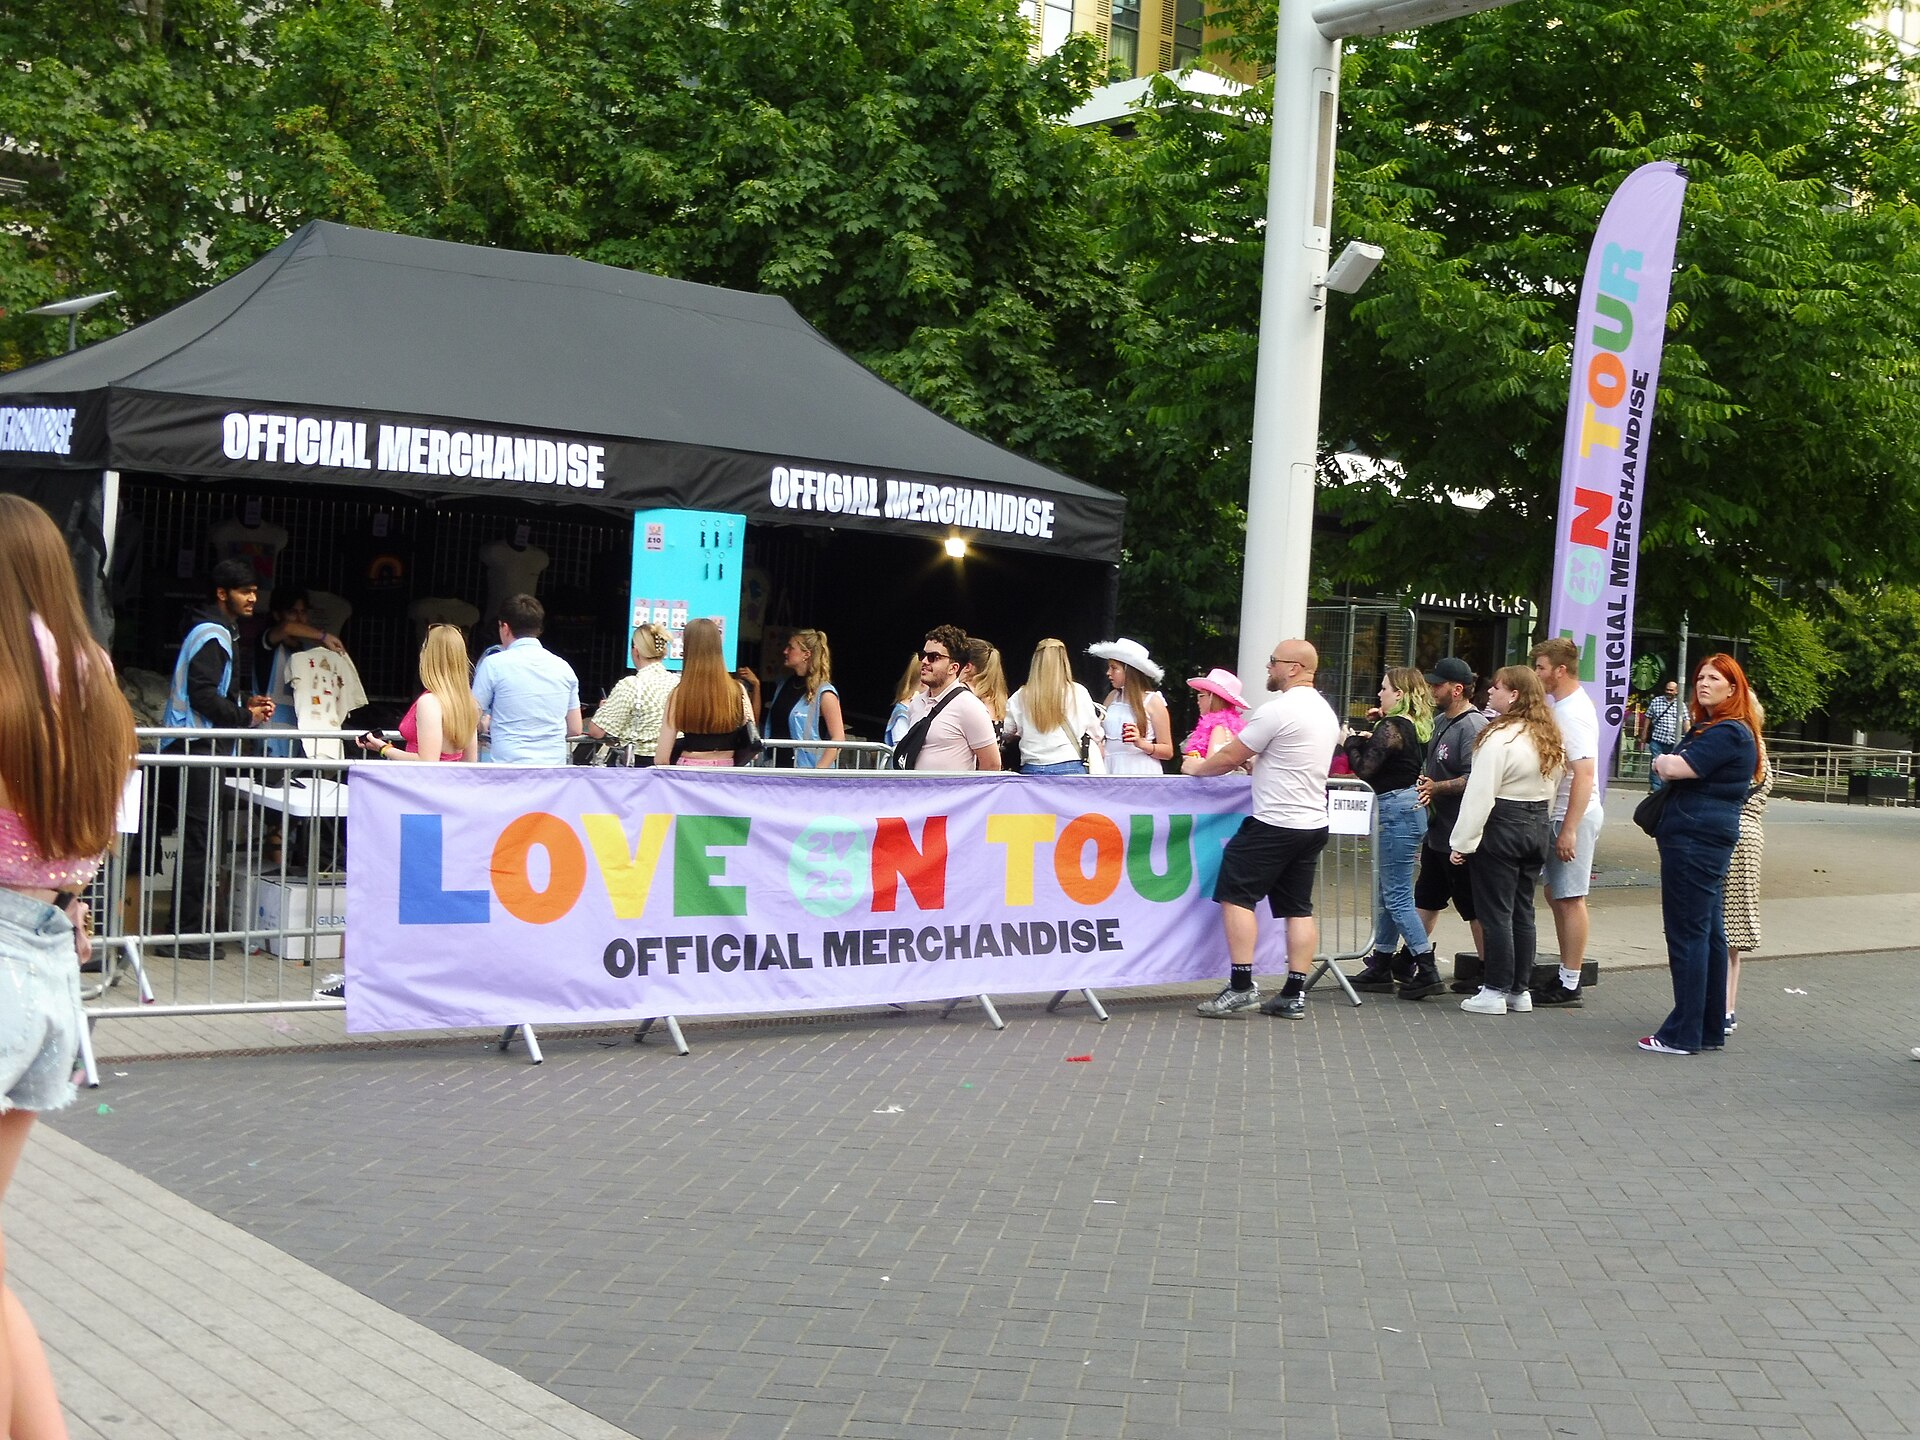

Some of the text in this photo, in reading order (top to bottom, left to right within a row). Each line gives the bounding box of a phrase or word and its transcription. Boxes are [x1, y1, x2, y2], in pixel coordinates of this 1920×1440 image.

[1581, 242, 1644, 458] TOUR
[222, 412, 605, 489] OFFICIAL MERCHANDISE
[769, 466, 1055, 539] OFFICIAL MERCHANDISE
[1604, 370, 1650, 728] OFFICIAL MERCHANDISE
[1333, 798, 1368, 812] ENTRANCE
[399, 811, 751, 925] LOVE
[603, 918, 1124, 979] OFFICIAL MERCHANDISE
